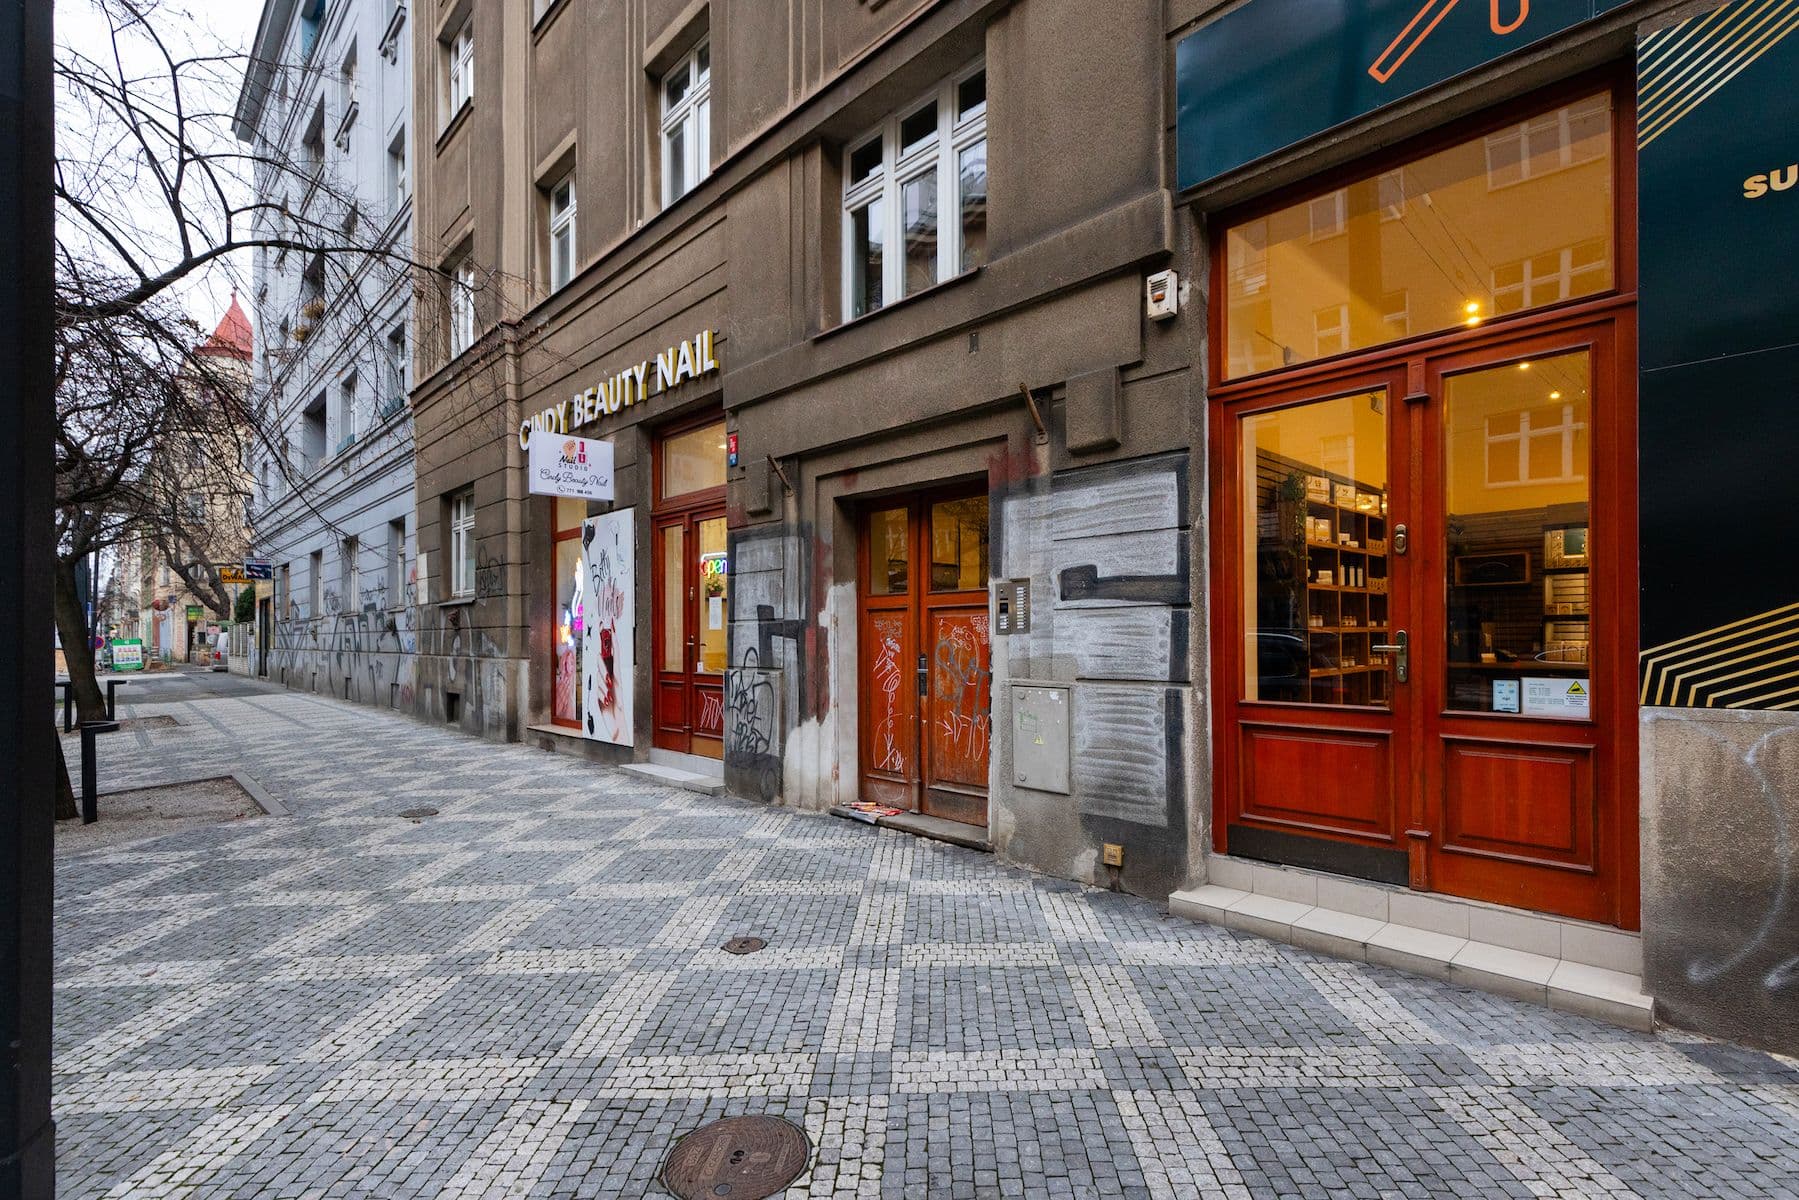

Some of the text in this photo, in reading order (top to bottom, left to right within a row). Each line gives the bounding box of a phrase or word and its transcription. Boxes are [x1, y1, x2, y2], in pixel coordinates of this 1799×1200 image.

[519, 329, 719, 450] CINDY BEAUTY NAIL
[559, 455, 577, 465] Nail
[558, 462, 588, 471] STUDIO
